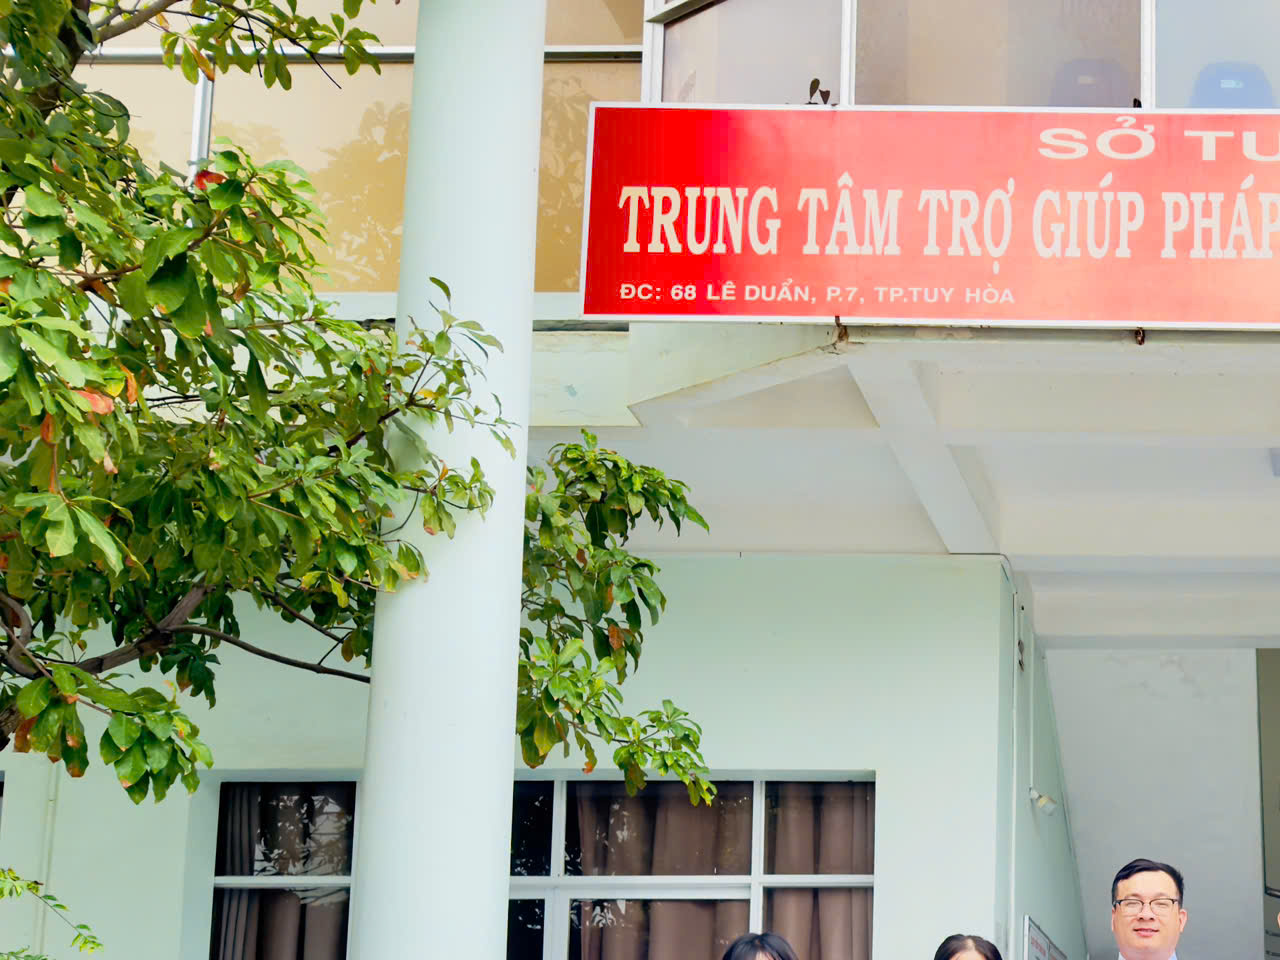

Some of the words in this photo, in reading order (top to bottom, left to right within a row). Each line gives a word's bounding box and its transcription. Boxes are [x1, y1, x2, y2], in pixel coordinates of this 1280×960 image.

[1038, 115, 1156, 160] SỞ
[618, 185, 782, 256] TRUNG
[797, 171, 903, 257] TÂM
[917, 177, 1016, 275] TRỢ
[1032, 172, 1145, 259] GIÚP
[619, 283, 662, 301] ĐC:
[671, 285, 697, 300] 68
[706, 281, 737, 301] LÊ
[744, 278, 817, 304] DUẨN,
[826, 286, 865, 304] P.7,
[874, 287, 955, 303] TP.TUY
[965, 282, 1016, 304] HÒA
